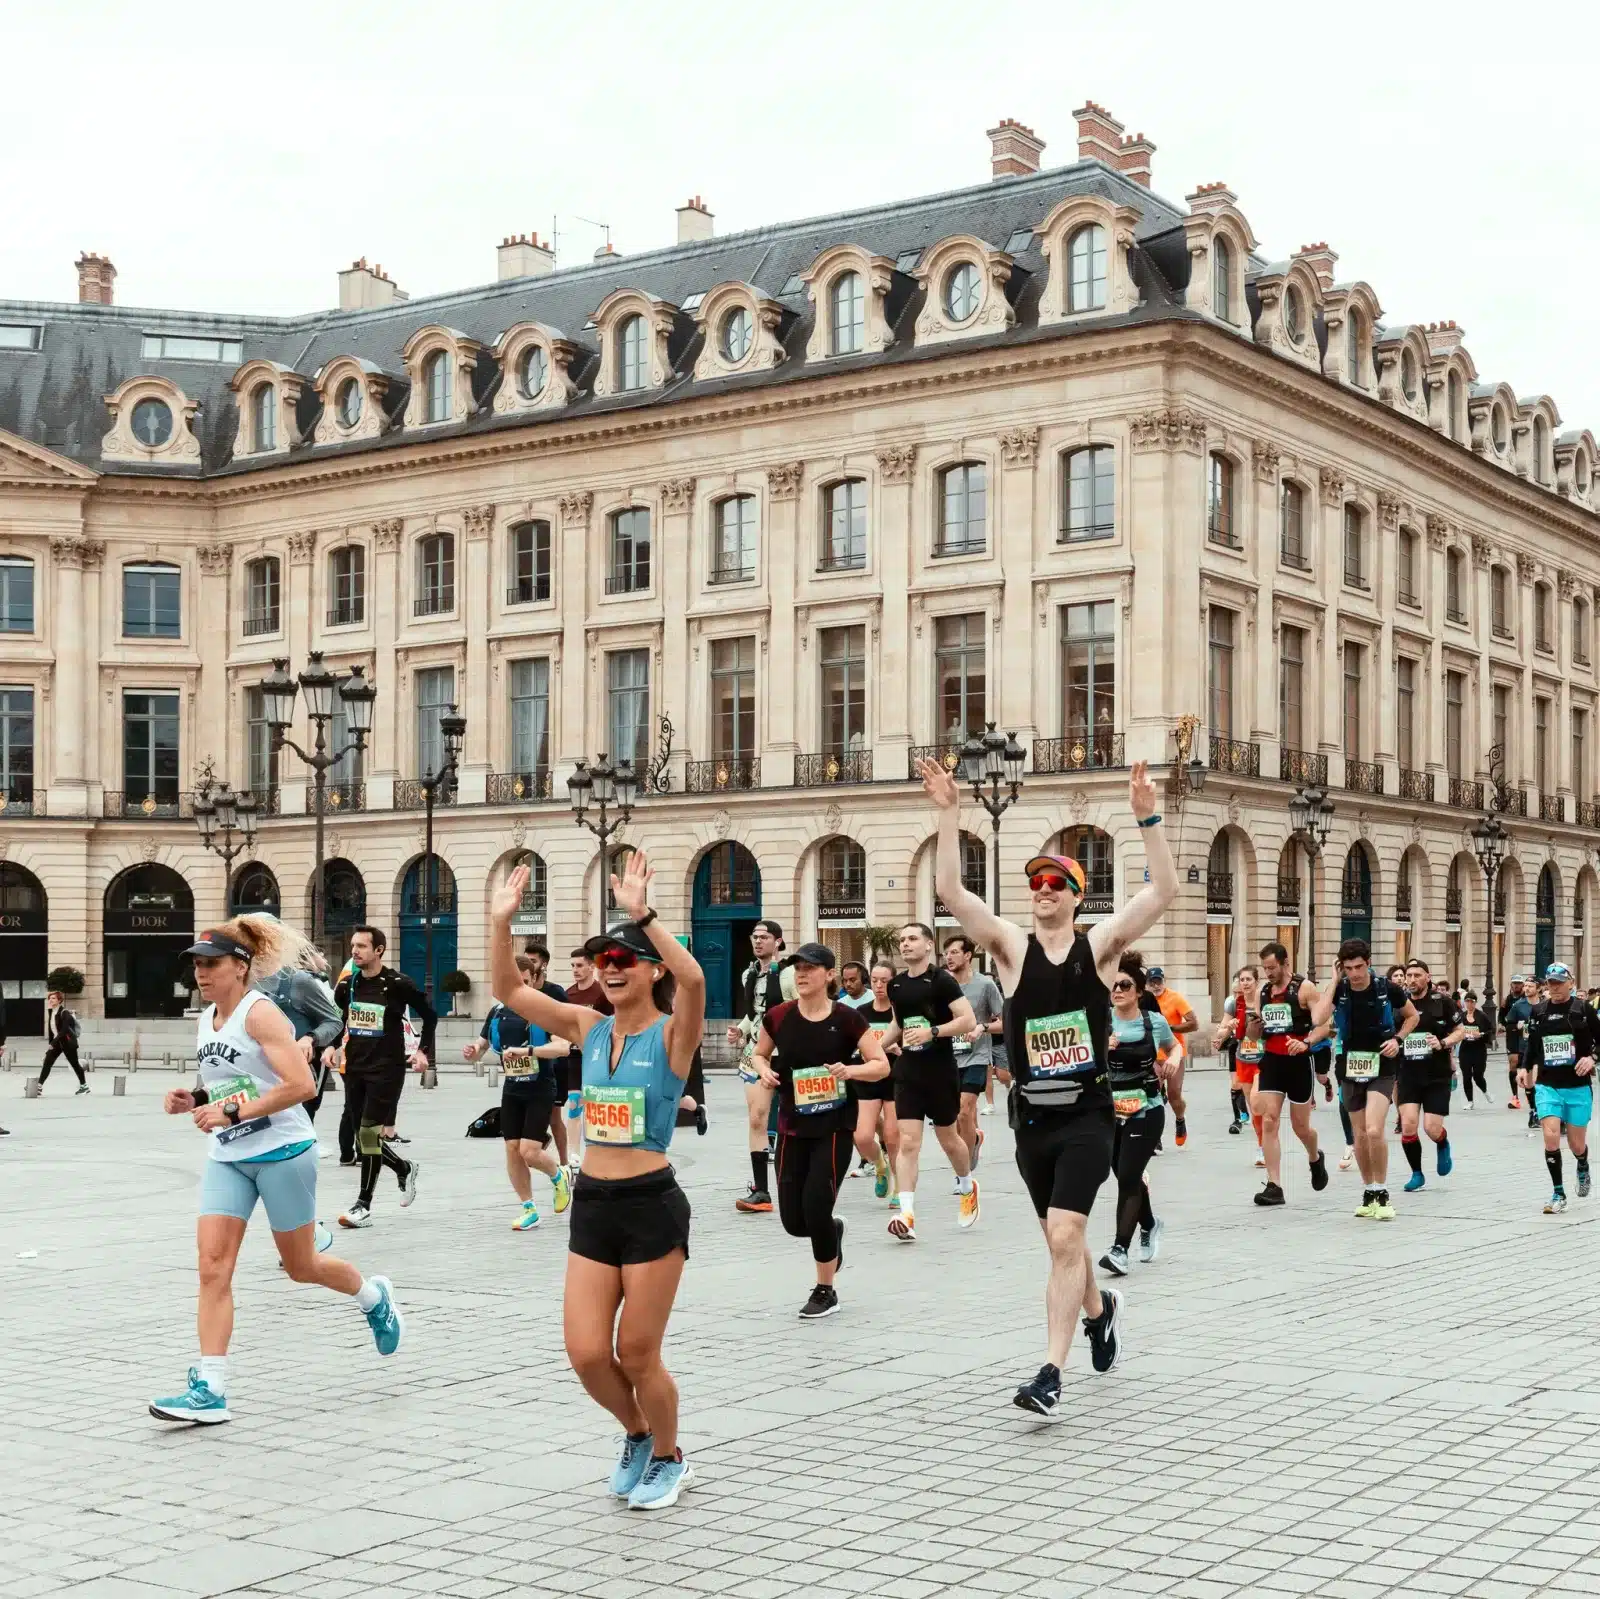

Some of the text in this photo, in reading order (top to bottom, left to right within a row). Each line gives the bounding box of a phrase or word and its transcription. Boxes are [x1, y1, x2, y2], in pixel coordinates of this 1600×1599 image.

[819, 907, 866, 915] LOUIS VUITTON
[1083, 901, 1114, 909] VUITTON
[131, 915, 168, 927] DIOR
[351, 1010, 376, 1022] 51383
[1034, 1014, 1074, 1028] Schneider
[1265, 1010, 1286, 1021] 52772
[1031, 1027, 1077, 1052] 49072
[197, 1041, 242, 1065] HOENIX
[1544, 1041, 1570, 1054] 38290
[506, 1056, 530, 1069] 51296
[1040, 1046, 1090, 1068] DAVID
[1348, 1059, 1373, 1070] 52601
[589, 1085, 628, 1097] Schneider
[796, 1075, 837, 1095] 69581
